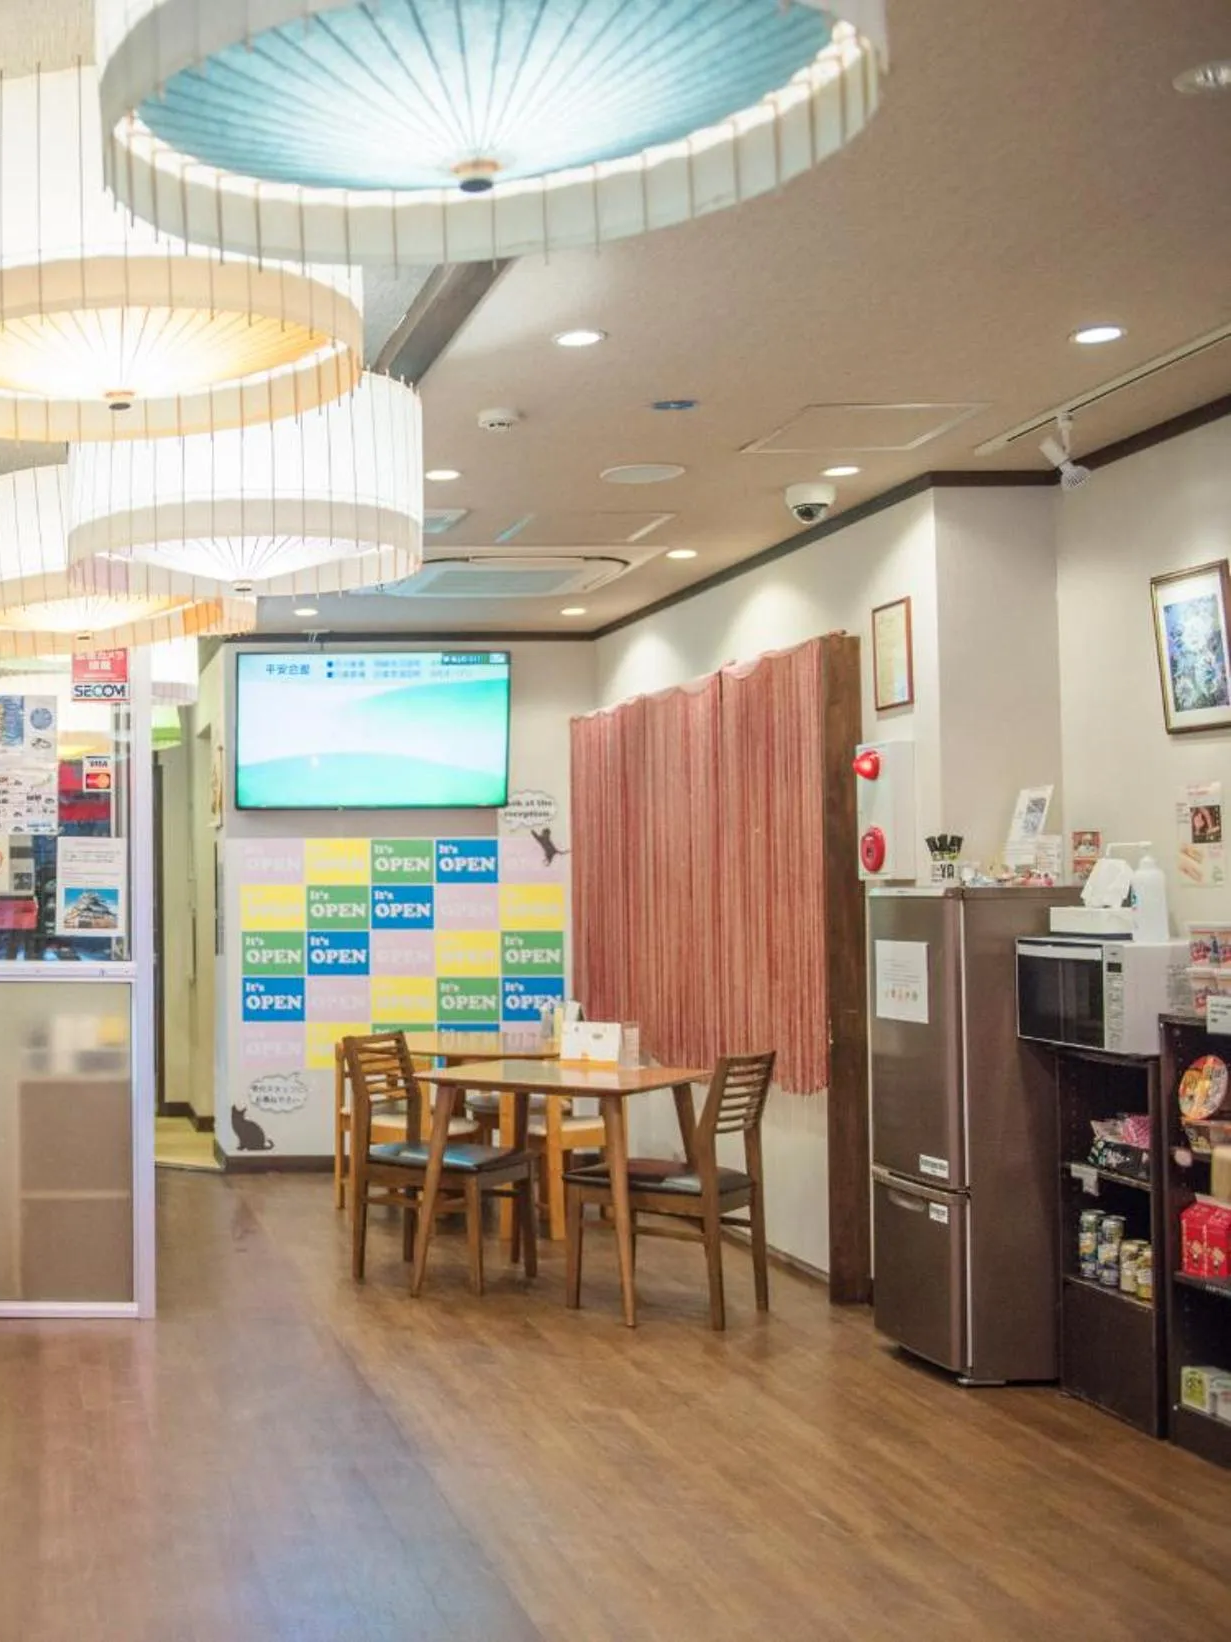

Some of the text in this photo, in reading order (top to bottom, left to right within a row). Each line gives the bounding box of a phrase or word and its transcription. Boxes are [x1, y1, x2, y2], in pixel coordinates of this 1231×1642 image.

[73, 685, 126, 698] SECOM
[374, 857, 431, 872] OPEN
[439, 857, 496, 872] OPEN
[310, 903, 367, 917] OPEN
[374, 903, 432, 918] OPEN
[245, 949, 302, 964] OPEN
[310, 949, 367, 964] OPEN
[505, 949, 562, 964] OPEN
[246, 995, 302, 1010] OPEN
[441, 995, 497, 1010] OPEN
